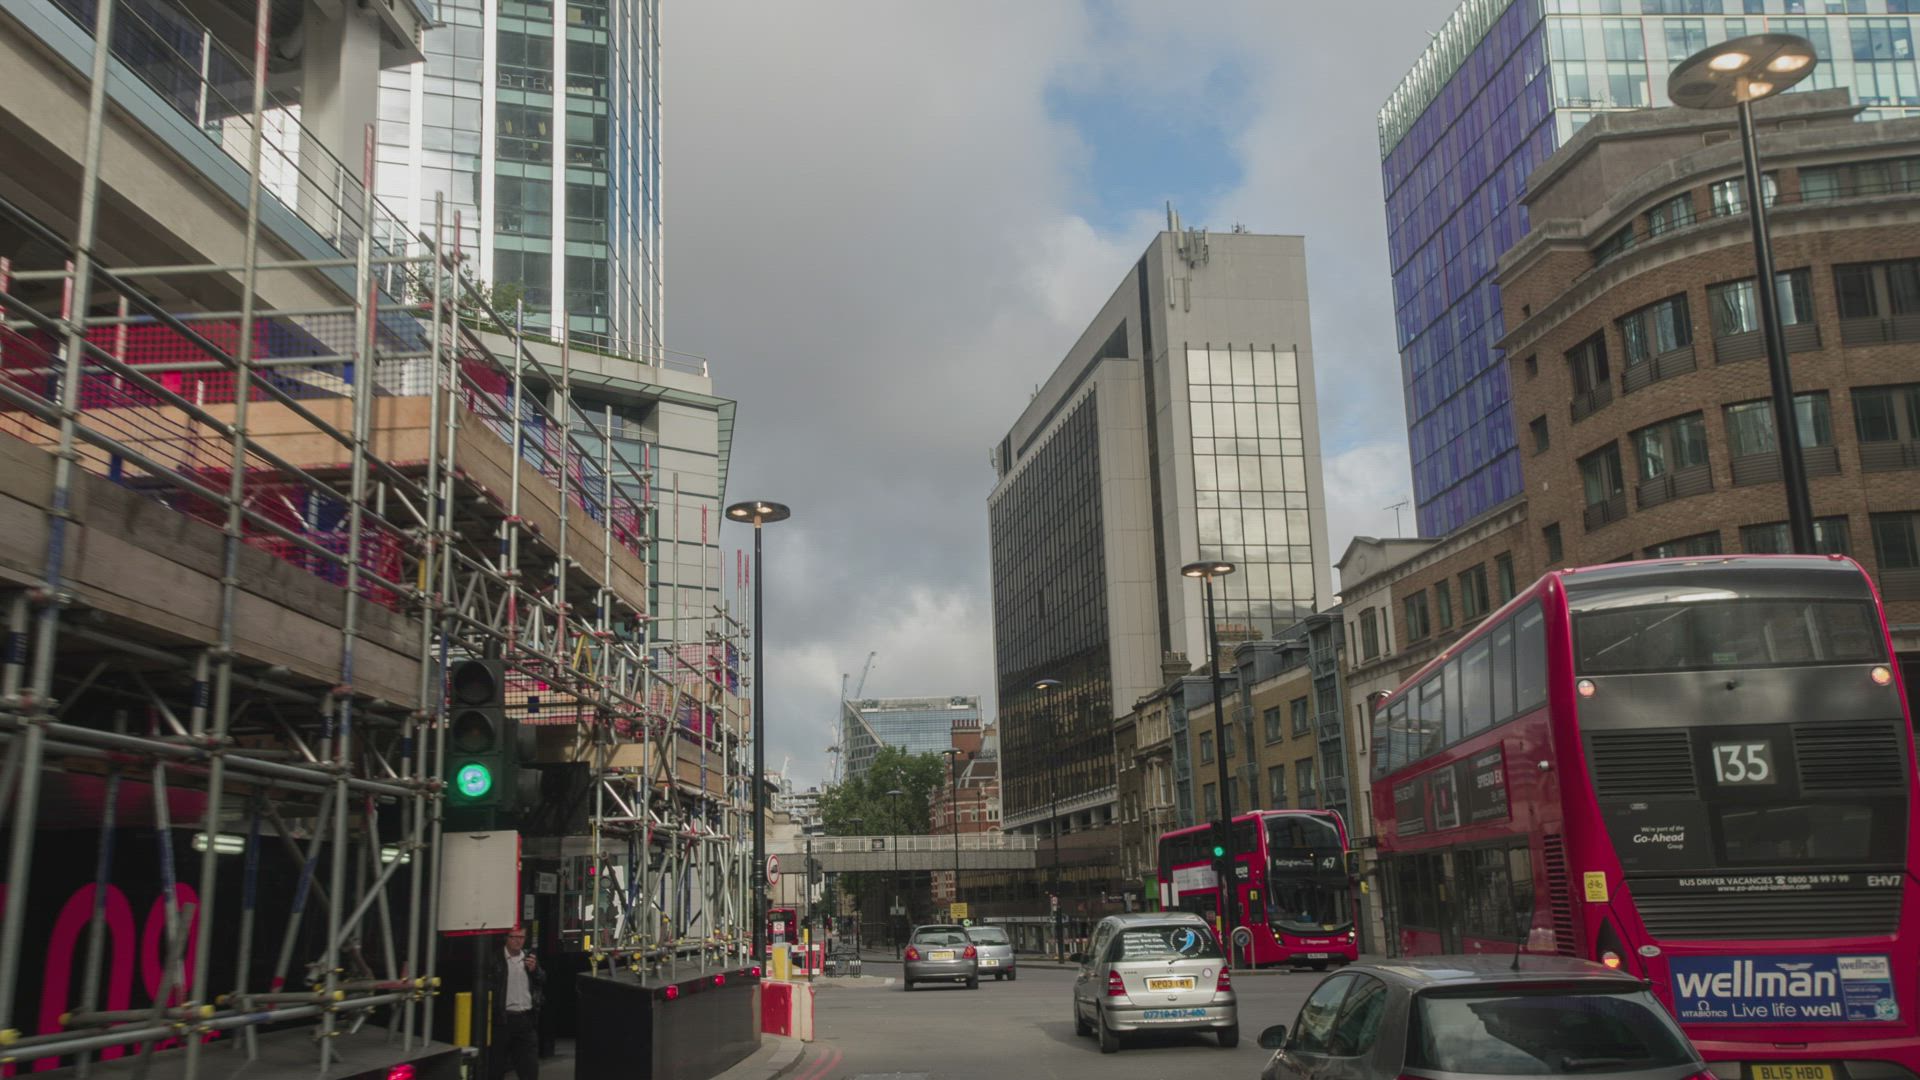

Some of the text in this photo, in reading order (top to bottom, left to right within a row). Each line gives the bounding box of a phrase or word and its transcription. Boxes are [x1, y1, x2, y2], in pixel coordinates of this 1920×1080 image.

[1712, 744, 1770, 783] 135
[1633, 832, 1684, 843] Go-Ahead
[1322, 857, 1335, 869] 47
[1679, 879, 1695, 887] BUS
[1697, 878, 1725, 886] DRIVER
[1726, 877, 1773, 885] VACANCIES
[1787, 876, 1807, 884] 0800
[1867, 875, 1901, 887] EHV7
[1676, 960, 1836, 998] wellman
[1681, 1010, 1728, 1018] VITABIOTICS
[1732, 1003, 1768, 1017] Live
[1772, 1002, 1797, 1017] life
[1801, 1002, 1842, 1017] well
[1761, 1067, 1793, 1080] BL15
